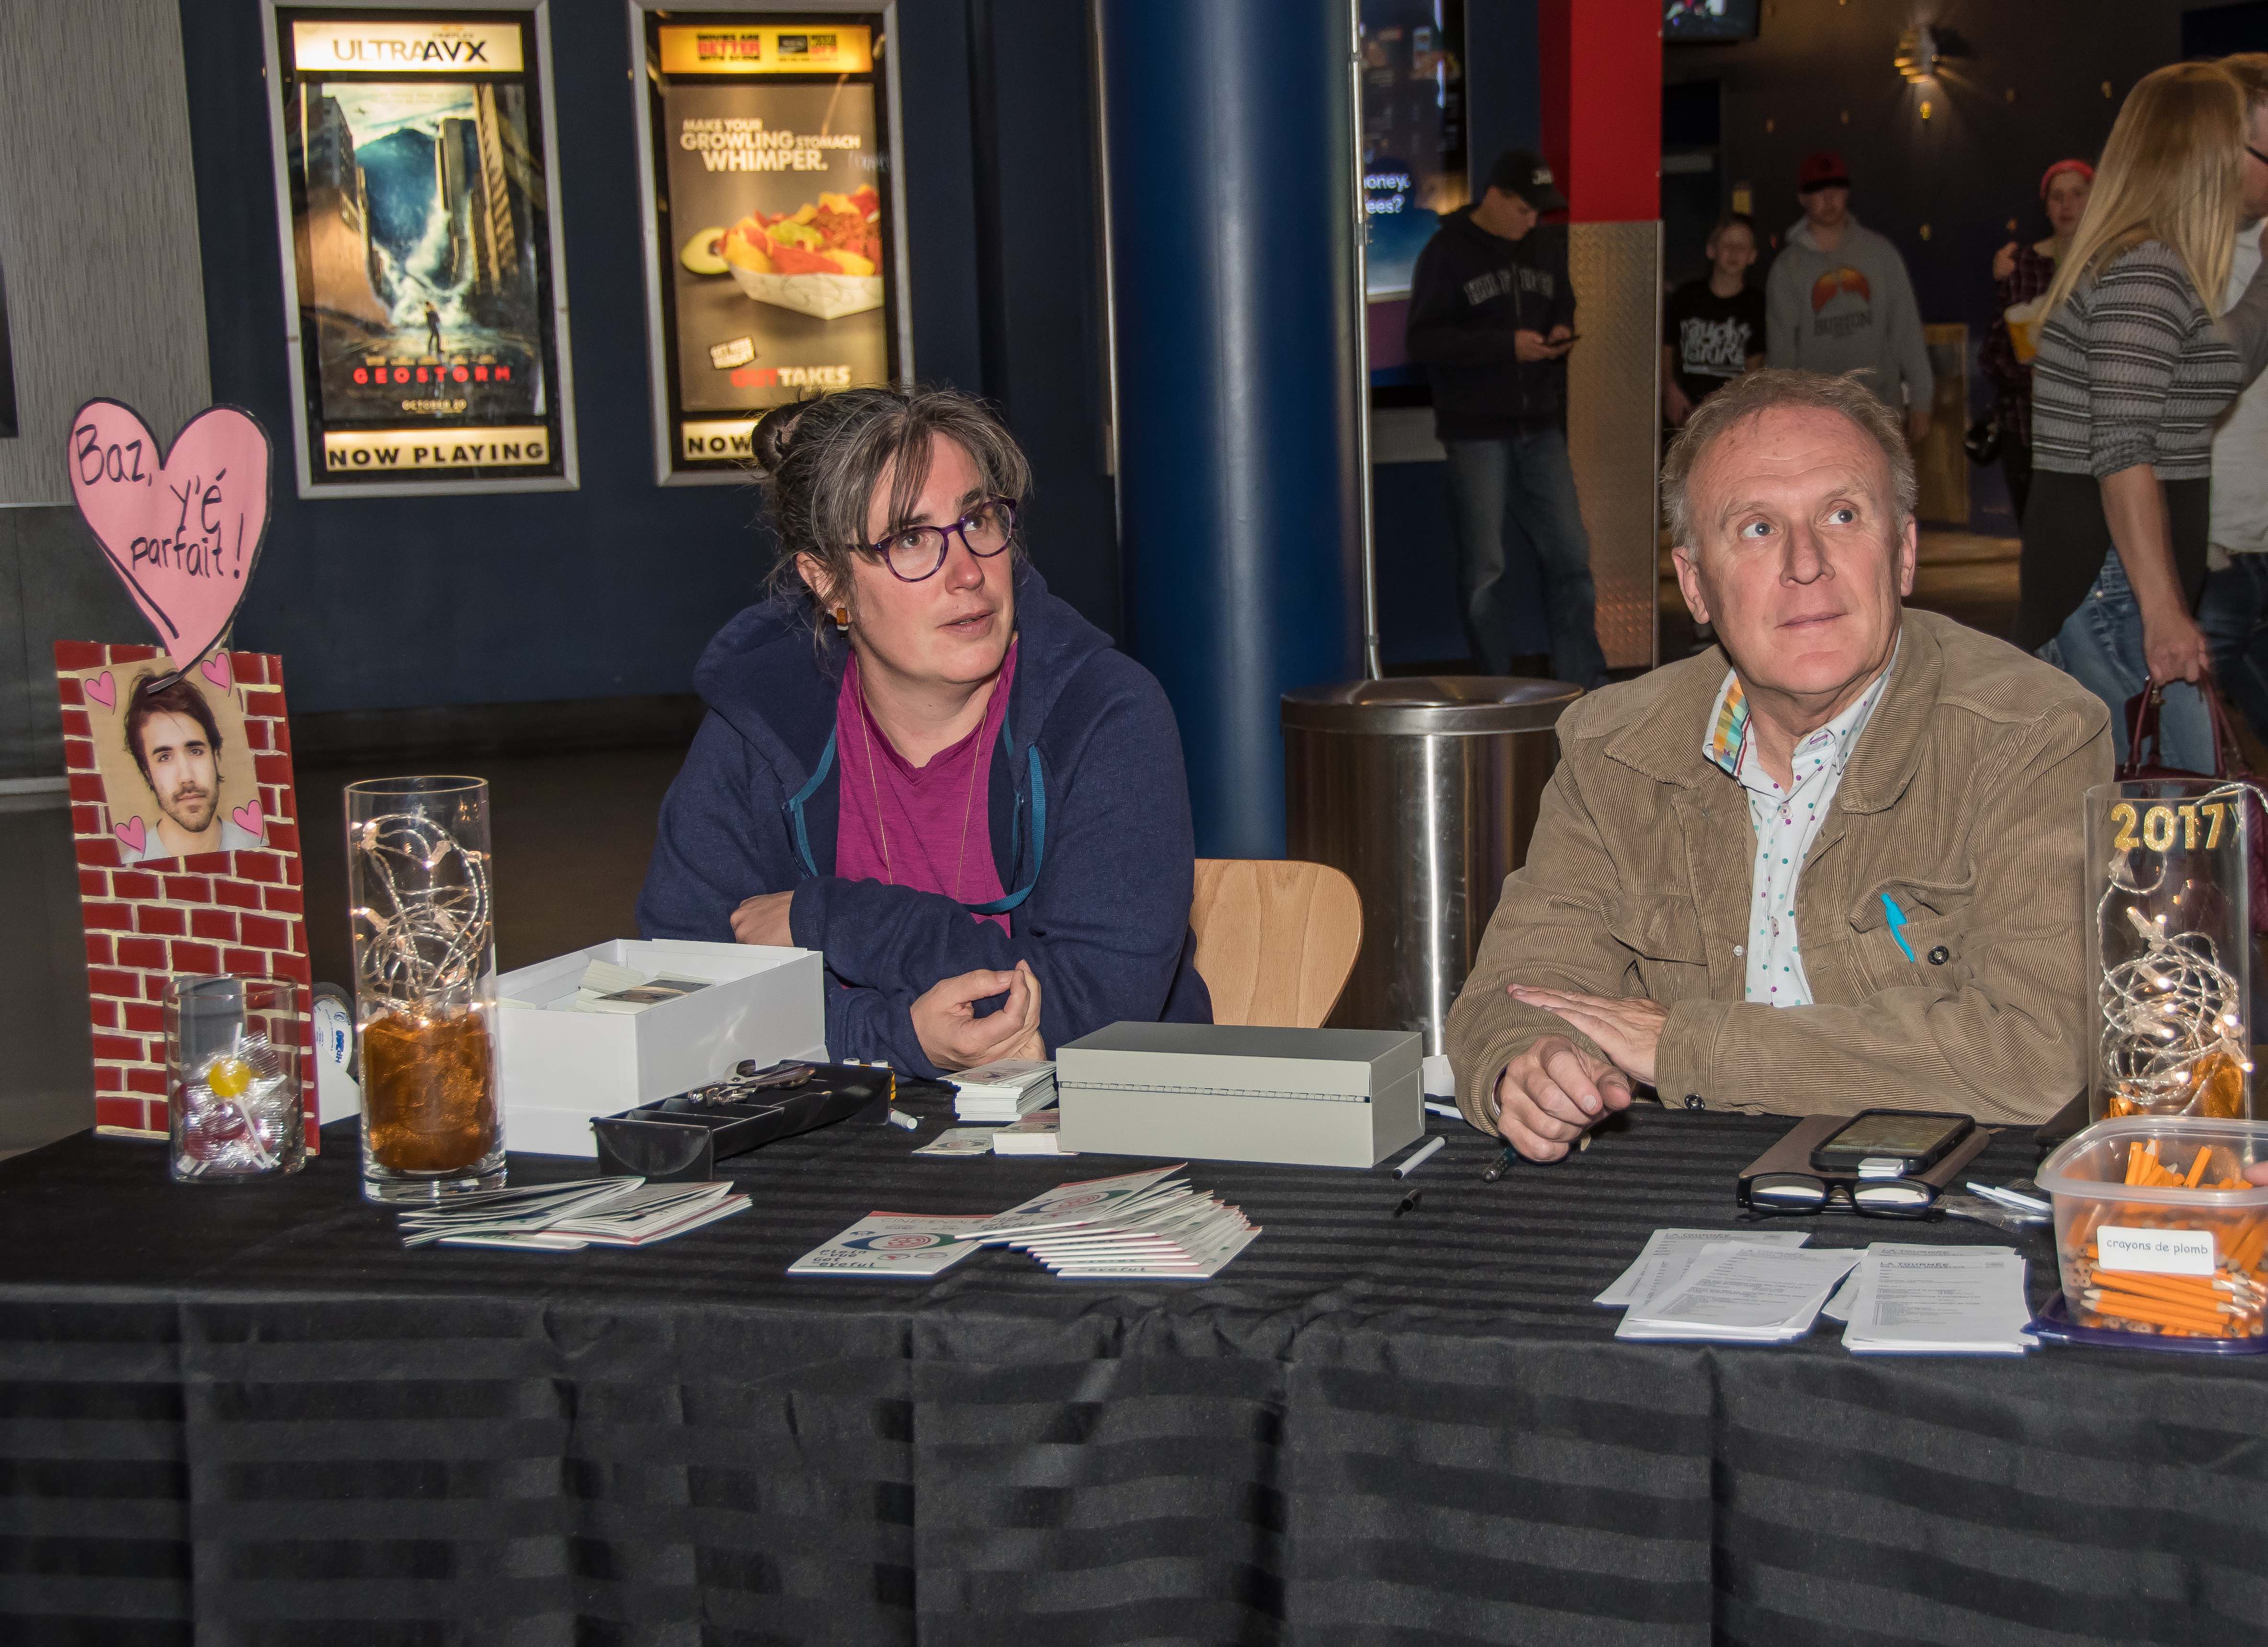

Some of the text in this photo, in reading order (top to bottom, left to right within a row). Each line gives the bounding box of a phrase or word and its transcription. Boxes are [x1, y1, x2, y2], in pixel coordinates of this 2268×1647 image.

[682, 117, 764, 132] MAKE YOUR
[680, 130, 862, 150] GROWLING STOMACH
[701, 149, 829, 171] WHIMPER.
[353, 365, 510, 385] GEOSTORM
[329, 442, 544, 466] NOW PLAYING
[688, 436, 751, 453] NOW
[76, 424, 153, 487] Baz,
[2111, 803, 2224, 851] 2017
[2107, 1239, 2208, 1255] crayons de plomb
